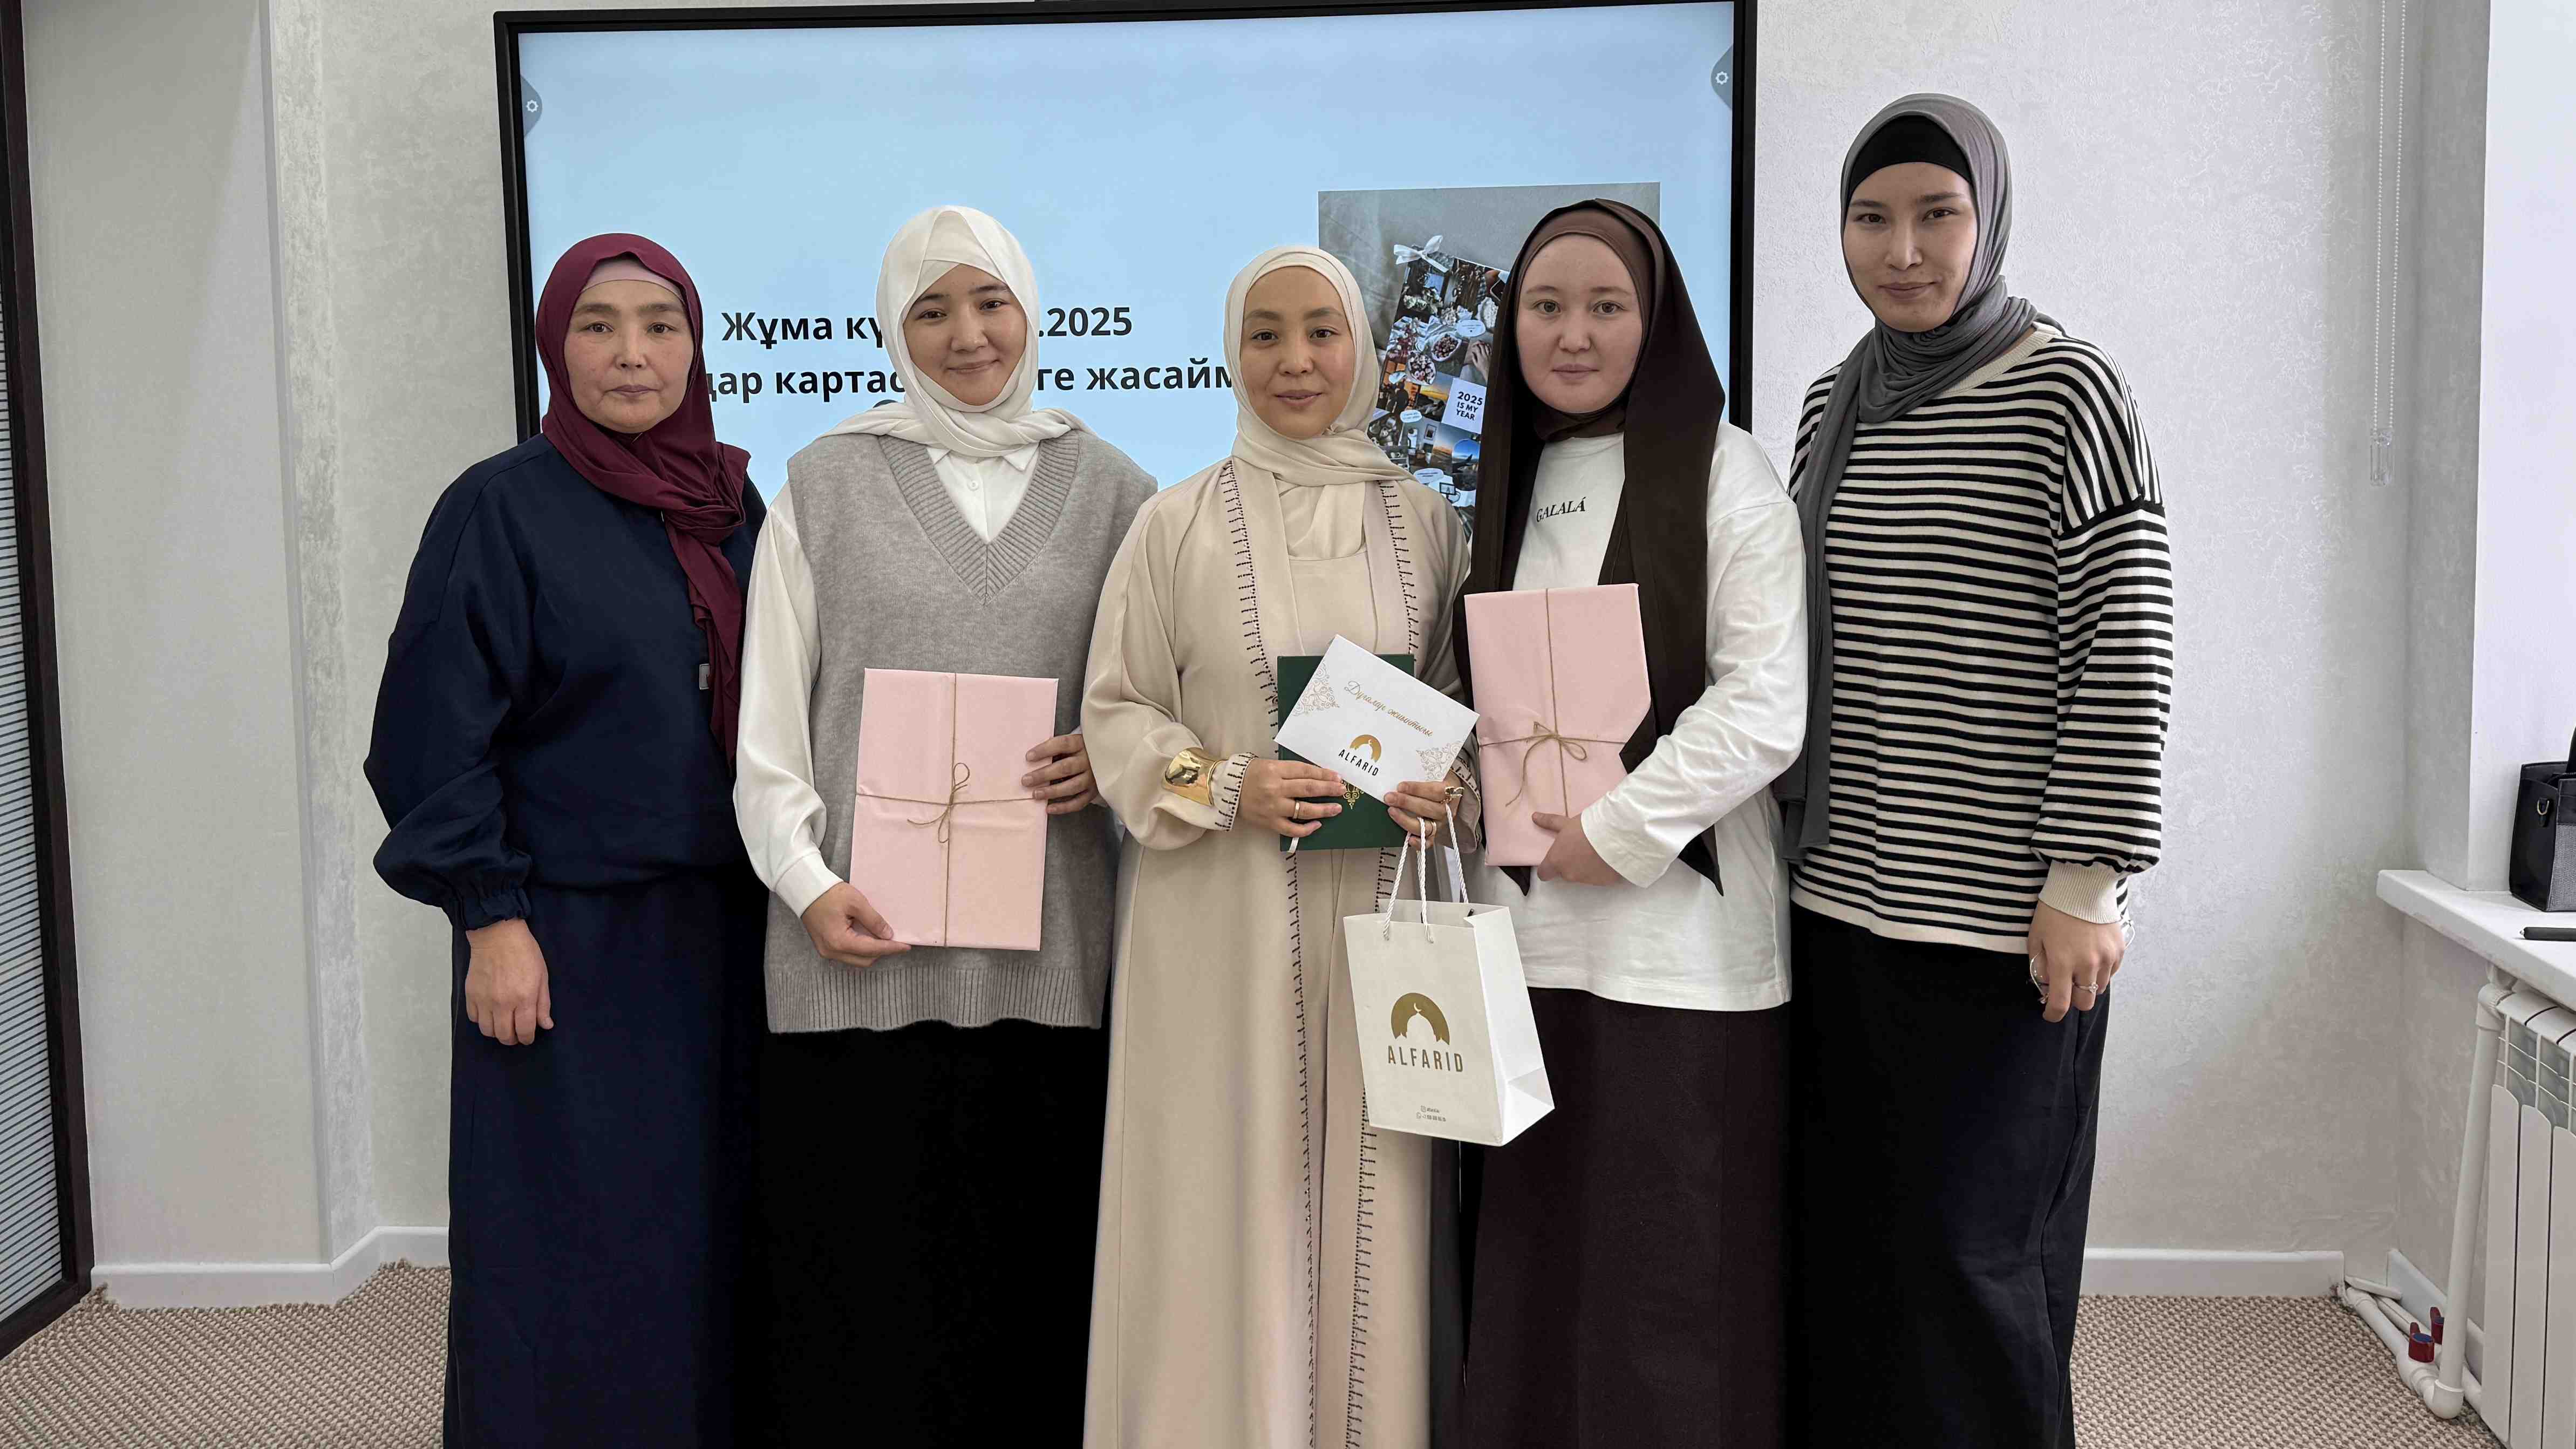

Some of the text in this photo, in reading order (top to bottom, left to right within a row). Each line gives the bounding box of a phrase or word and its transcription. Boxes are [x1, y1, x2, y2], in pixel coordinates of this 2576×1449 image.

[721, 311, 833, 350] Жұма
[1457, 391, 1483, 406] 2025
[1466, 404, 1478, 413] MY
[1456, 409, 1475, 421] YEAR
[1536, 496, 1587, 523] GALALÁ
[1338, 749, 1379, 776] ALFARID
[1388, 1045, 1463, 1072] ALFARID
